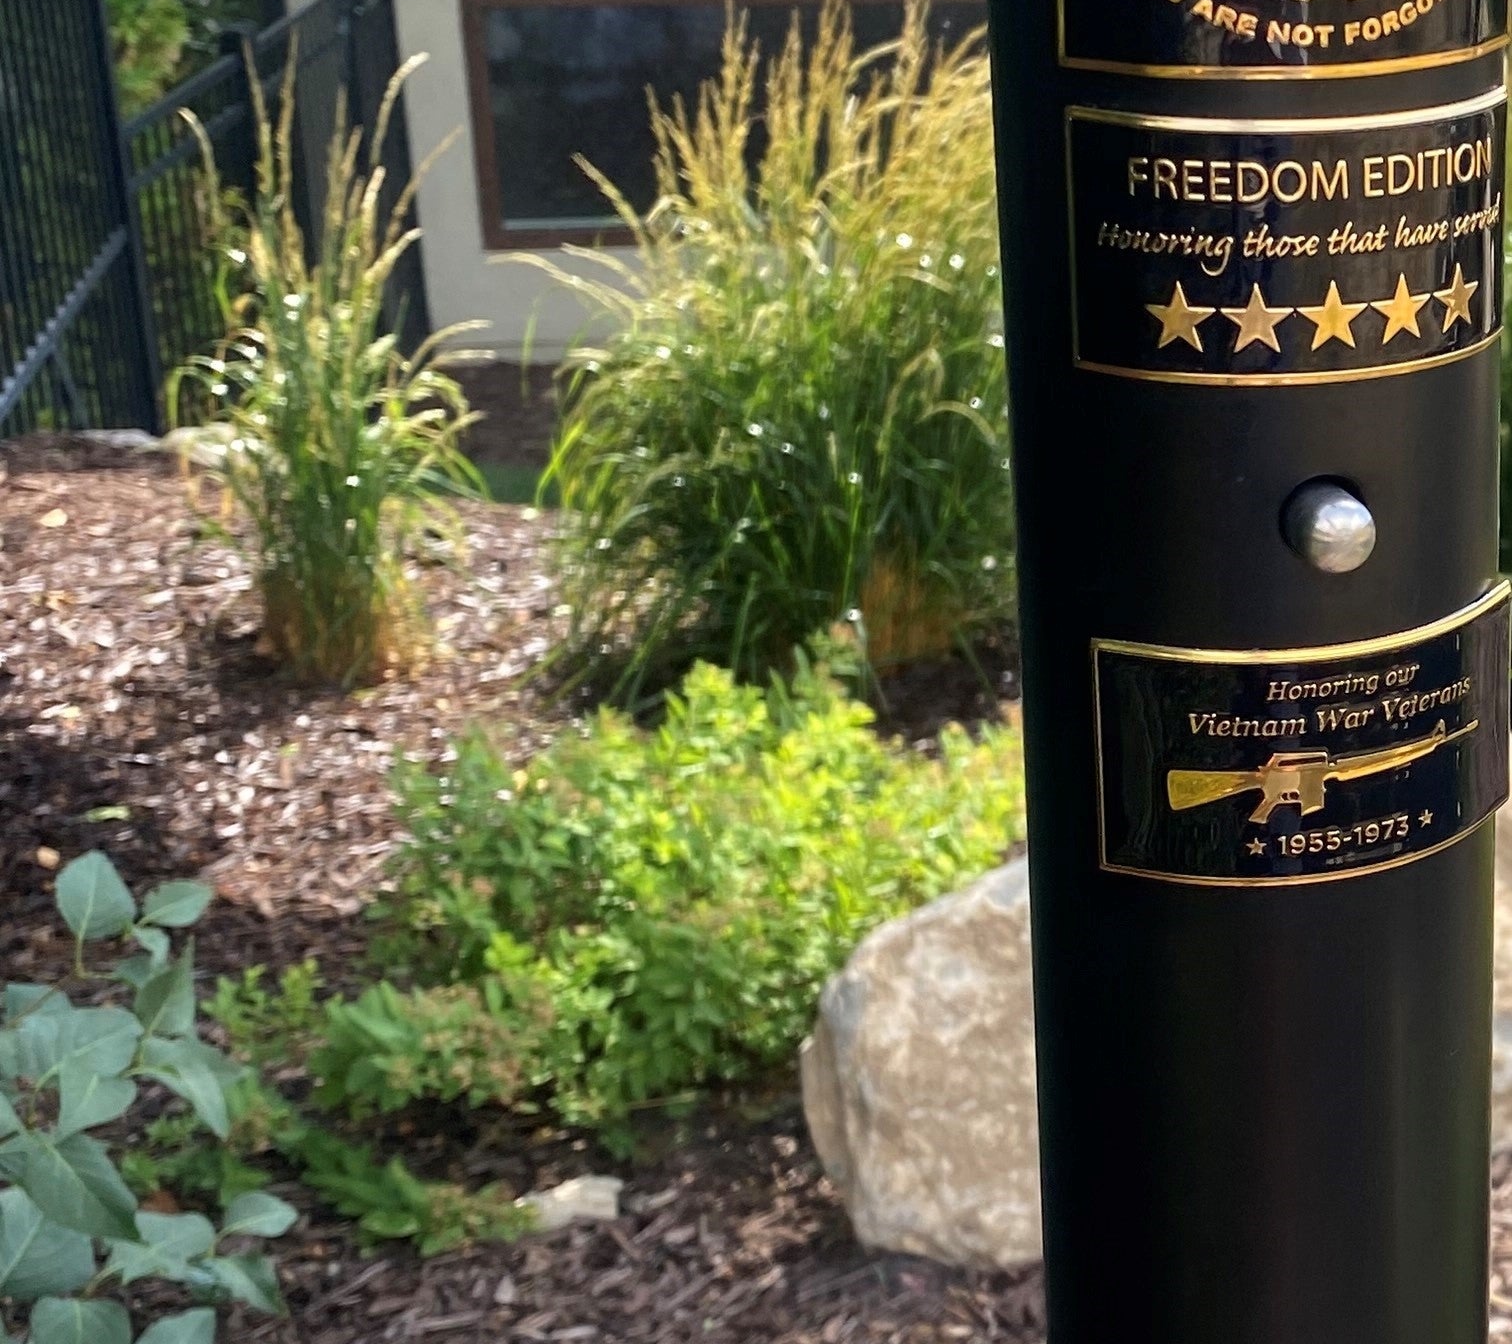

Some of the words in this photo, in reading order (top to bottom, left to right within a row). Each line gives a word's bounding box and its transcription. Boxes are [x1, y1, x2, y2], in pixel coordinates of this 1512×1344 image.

[1267, 19, 1336, 48] NOT
[1127, 156, 1350, 205] FREEDOM
[1362, 136, 1493, 198] EDITION
[1096, 220, 1235, 277] Honoring
[1242, 222, 1319, 258] those
[1326, 219, 1388, 255] that
[1396, 213, 1449, 249] have
[1187, 711, 1307, 739] Vietnam
[1316, 704, 1376, 733] War
[1381, 675, 1473, 721] Veterans
[1266, 670, 1380, 703] Honoring
[1385, 660, 1422, 688] our
[1276, 813, 1411, 856] 1955-1973
